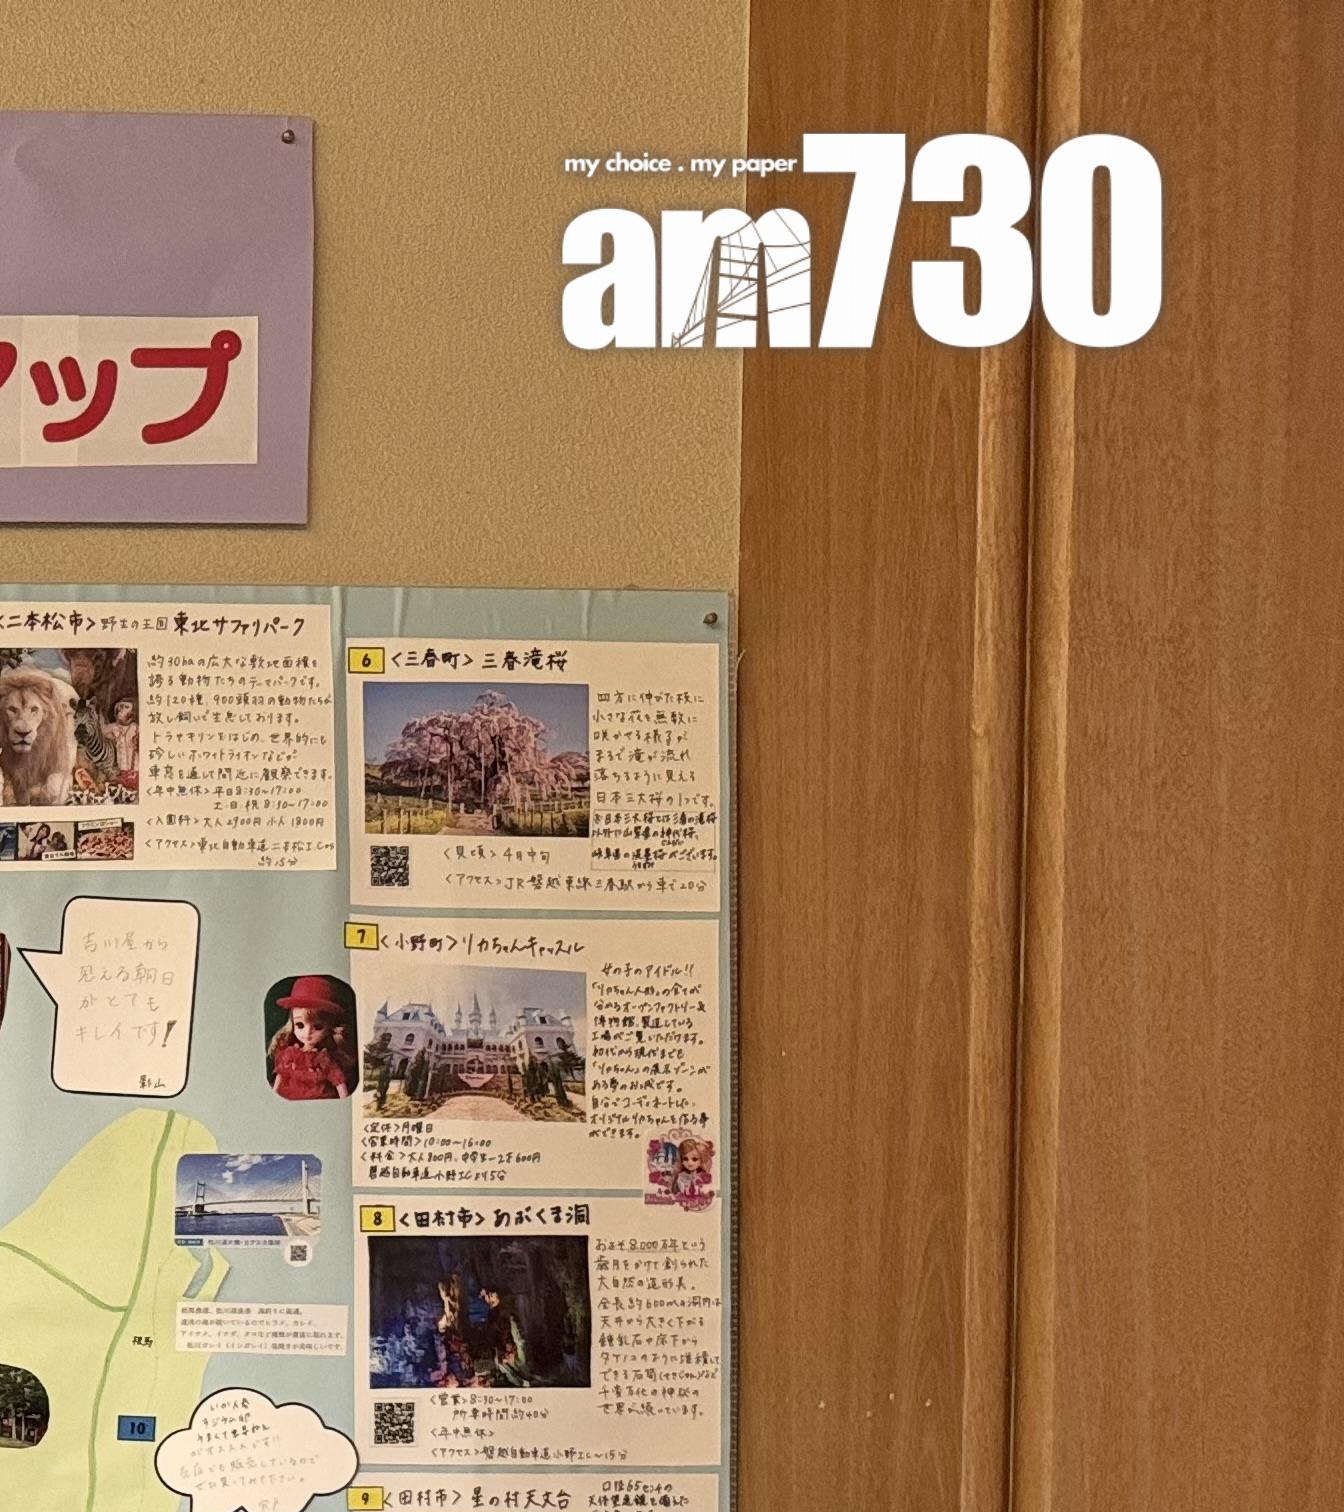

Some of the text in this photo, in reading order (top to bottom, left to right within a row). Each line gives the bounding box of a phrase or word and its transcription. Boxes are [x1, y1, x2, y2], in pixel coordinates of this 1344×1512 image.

[361, 653, 372, 668] 6
[481, 646, 568, 673] 三春滝桜
[356, 928, 366, 944] 7
[78, 963, 175, 985] 見える朝日
[373, 1211, 383, 1226] 8
[493, 1203, 591, 1228] あぶくま洞
[130, 1421, 146, 1435] 10
[361, 1492, 370, 1505] 9
[471, 1485, 572, 1511] 星の村天文台
